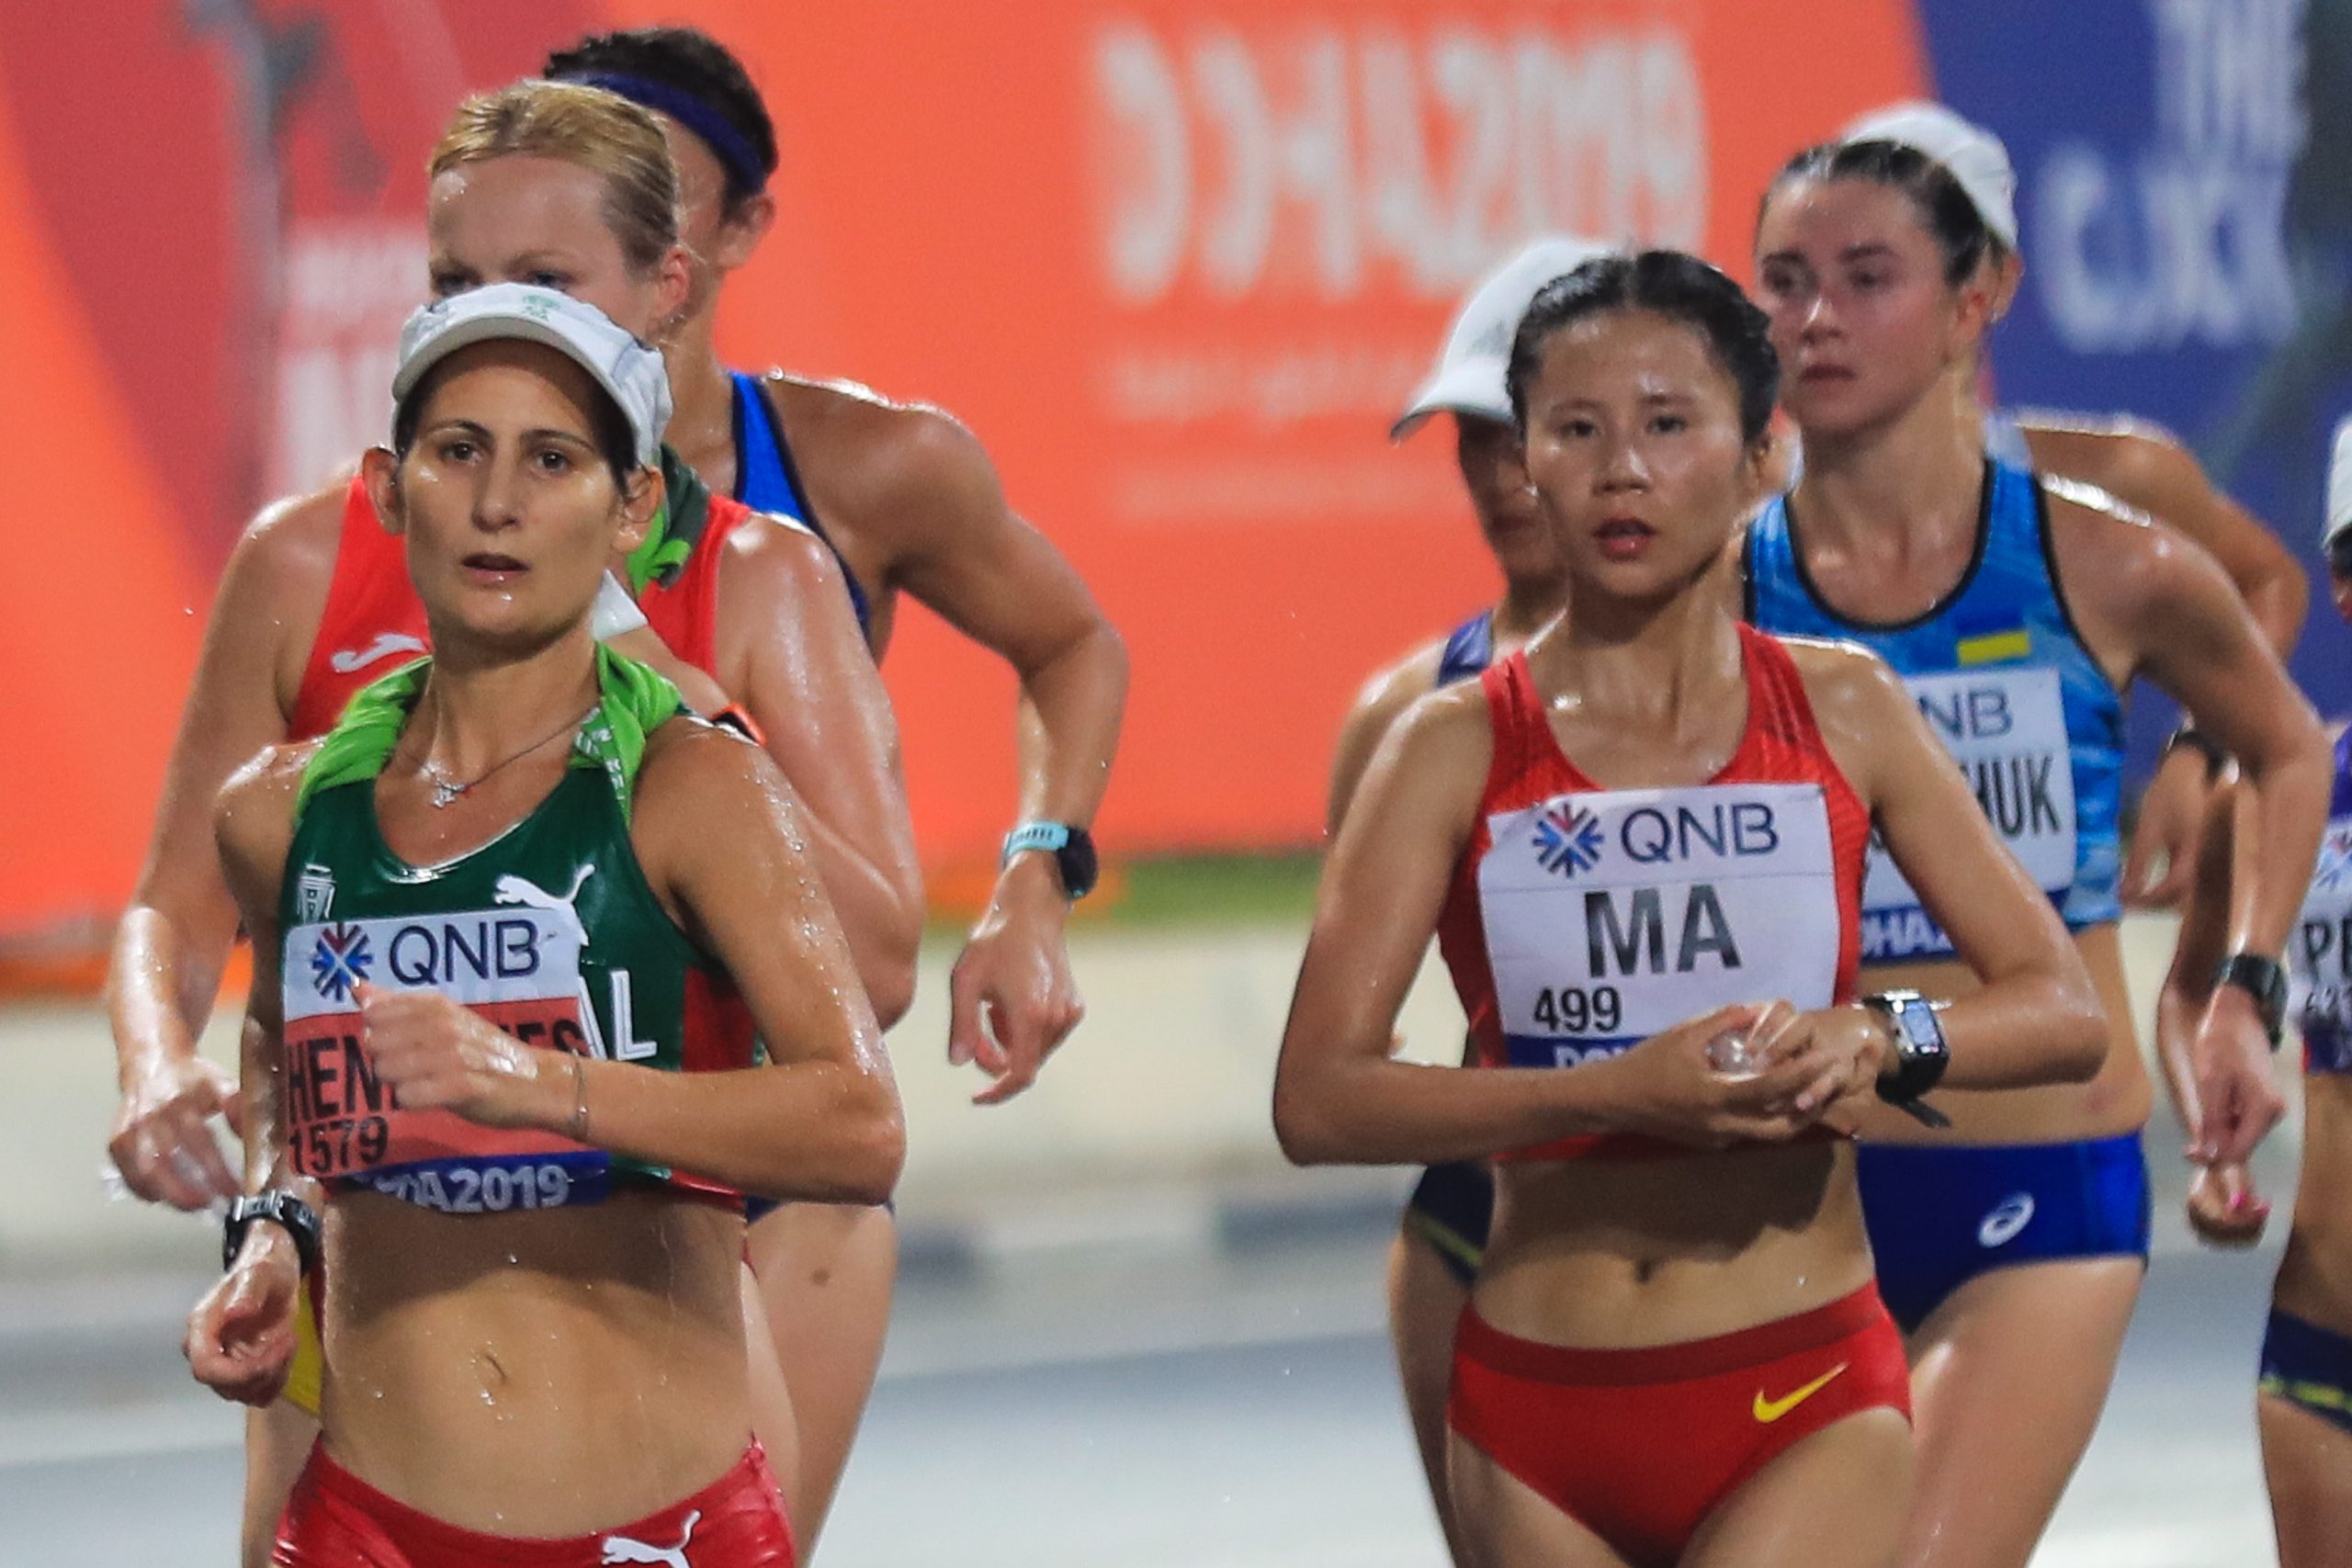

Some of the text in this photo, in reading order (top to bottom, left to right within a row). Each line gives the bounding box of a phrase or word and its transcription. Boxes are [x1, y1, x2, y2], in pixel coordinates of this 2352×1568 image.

[1917, 689, 2013, 739] NB
[1621, 802, 1779, 863] QNB
[390, 919, 540, 986] QNB
[1585, 884, 1742, 978] MA
[1533, 986, 1622, 1032] 499
[288, 1116, 388, 1174] 1579
